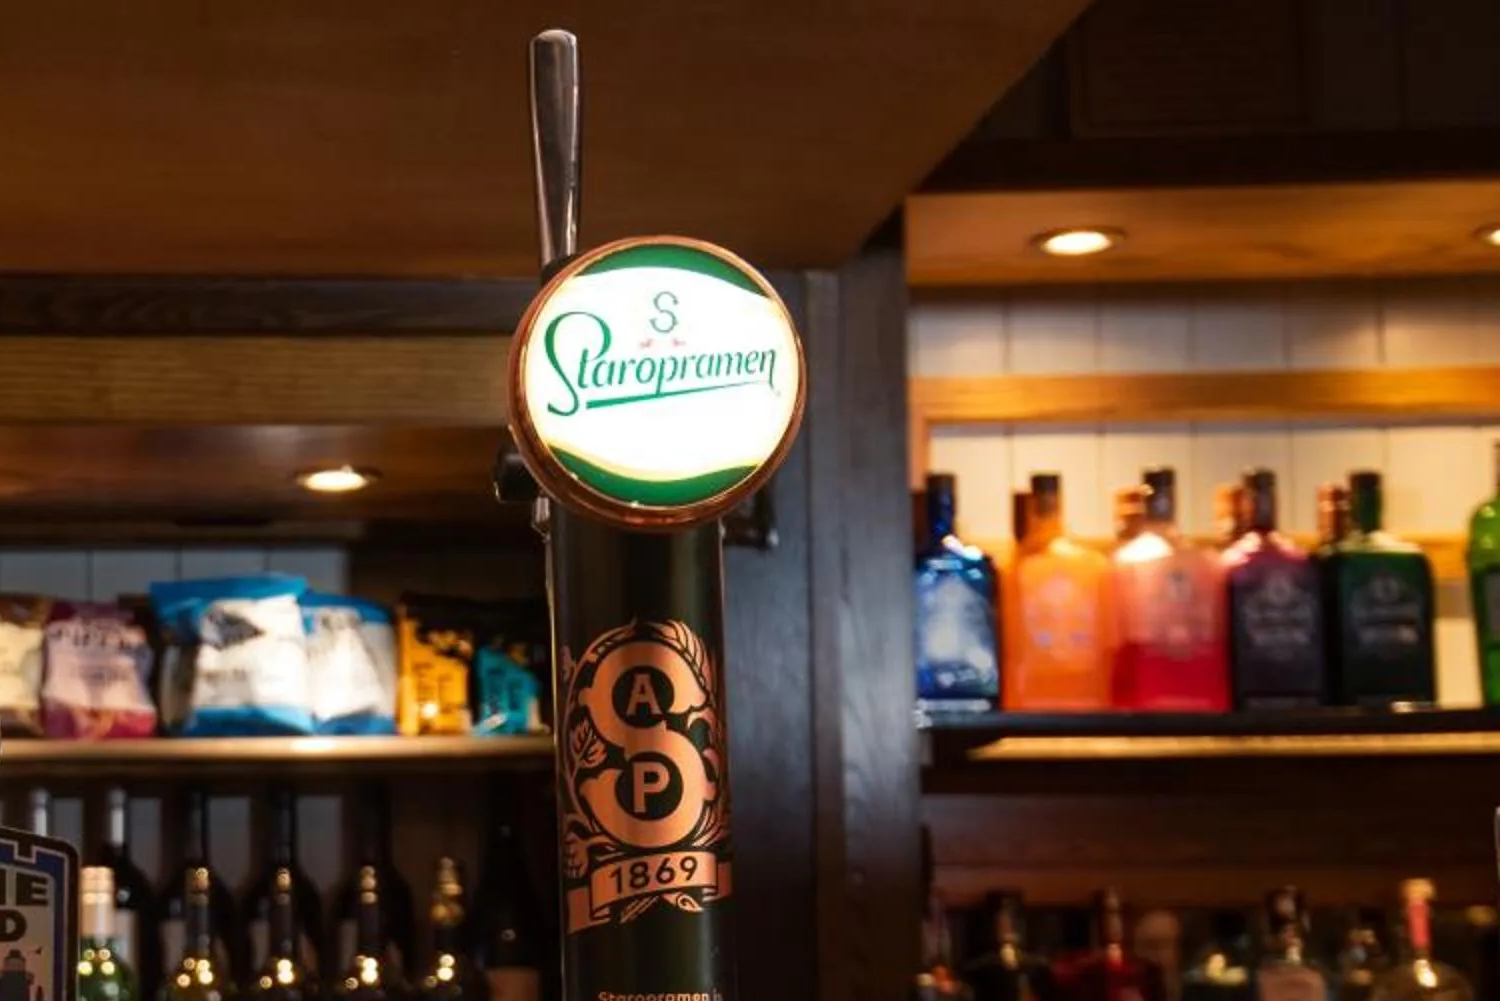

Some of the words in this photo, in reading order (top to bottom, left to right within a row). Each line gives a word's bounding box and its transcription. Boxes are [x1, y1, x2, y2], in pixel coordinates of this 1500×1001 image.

[649, 290, 680, 334] S
[543, 310, 783, 418] Staropramen
[625, 672, 663, 717] A
[630, 760, 671, 814] P
[607, 855, 699, 895] 1869
